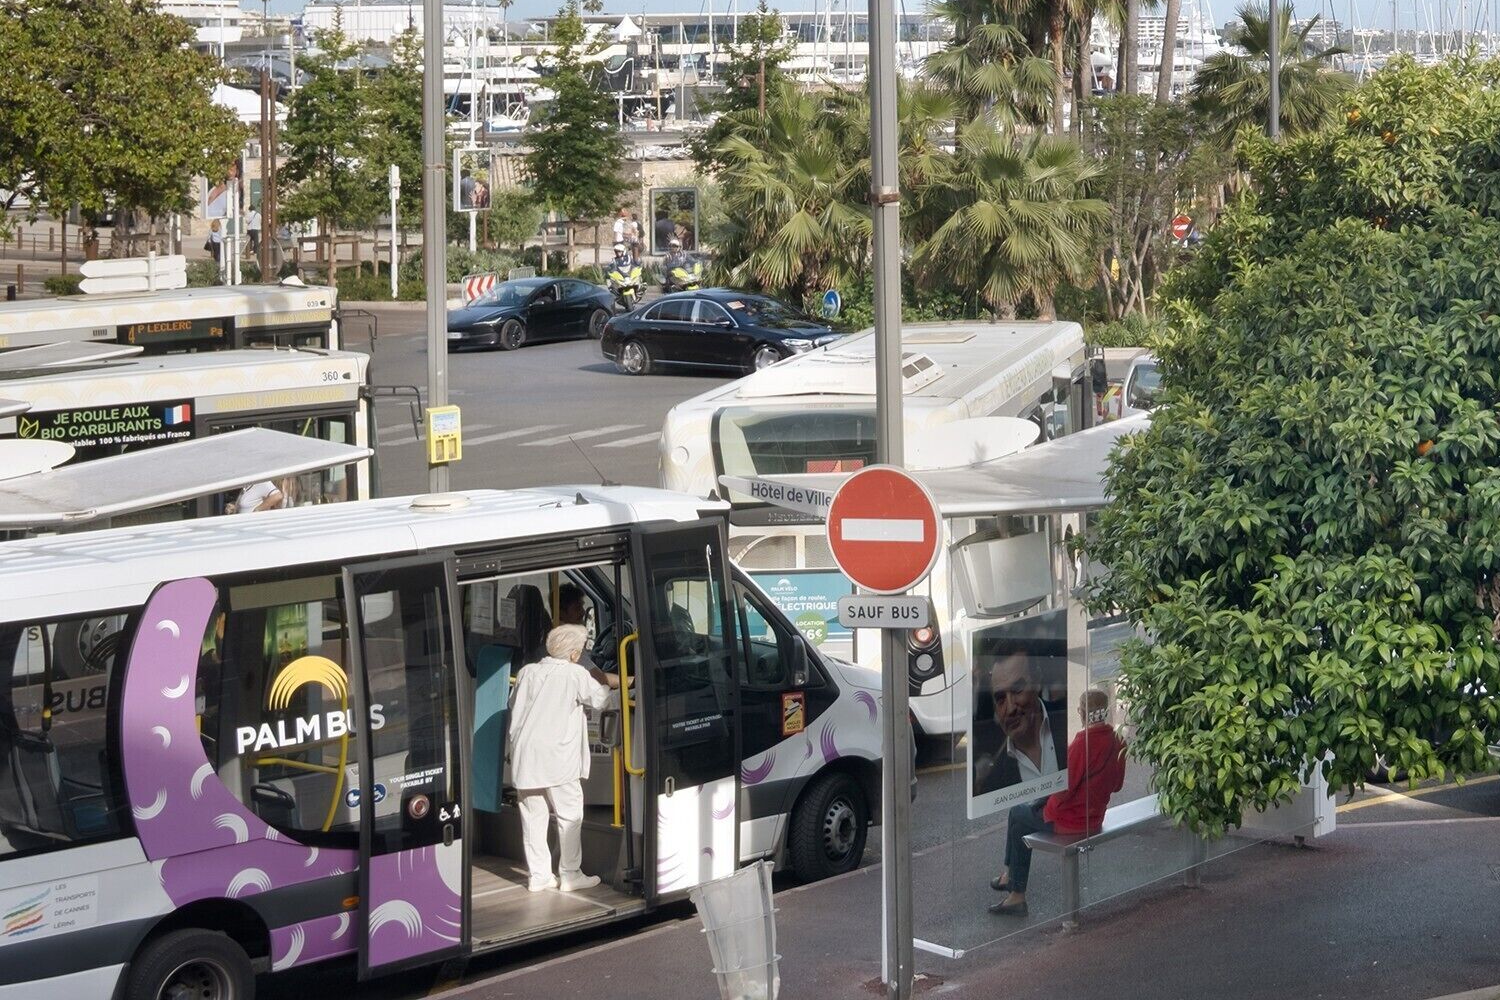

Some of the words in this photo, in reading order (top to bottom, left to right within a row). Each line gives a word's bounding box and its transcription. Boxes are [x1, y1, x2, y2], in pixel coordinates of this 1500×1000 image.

[128, 326, 136, 344] 4
[137, 324, 145, 334] P
[147, 320, 193, 334] LECLERC
[322, 370, 339, 382] 360
[53, 413, 70, 425] JE
[73, 408, 119, 423] ROULE
[120, 405, 150, 419] AUX
[41, 427, 65, 440] BIO
[68, 418, 162, 438] CARBURANTS
[99, 437, 113, 446] 100
[114, 436, 121, 444] %
[122, 432, 156, 444] fabriqués
[167, 429, 191, 438] France
[751, 483, 784, 500] Hôtel
[787, 489, 803, 503] de
[805, 490, 832, 508] Ville
[848, 605, 885, 619] SAUF
[891, 605, 920, 620] BUS
[235, 713, 321, 755] PALM
[389, 774, 405, 784] YOUR
[405, 770, 424, 781] SINGLE
[424, 766, 443, 777] TICKET
[400, 777, 424, 789] PAYABLE
[425, 776, 433, 785] BY
[993, 794, 1008, 806] JEAN
[1009, 787, 1037, 801] DUJARDIN
[1040, 781, 1053, 791] 2022
[55, 883, 67, 891] LES
[55, 889, 97, 904] TRANSPORTS
[54, 909, 62, 917] DE
[64, 904, 90, 915] CANNES
